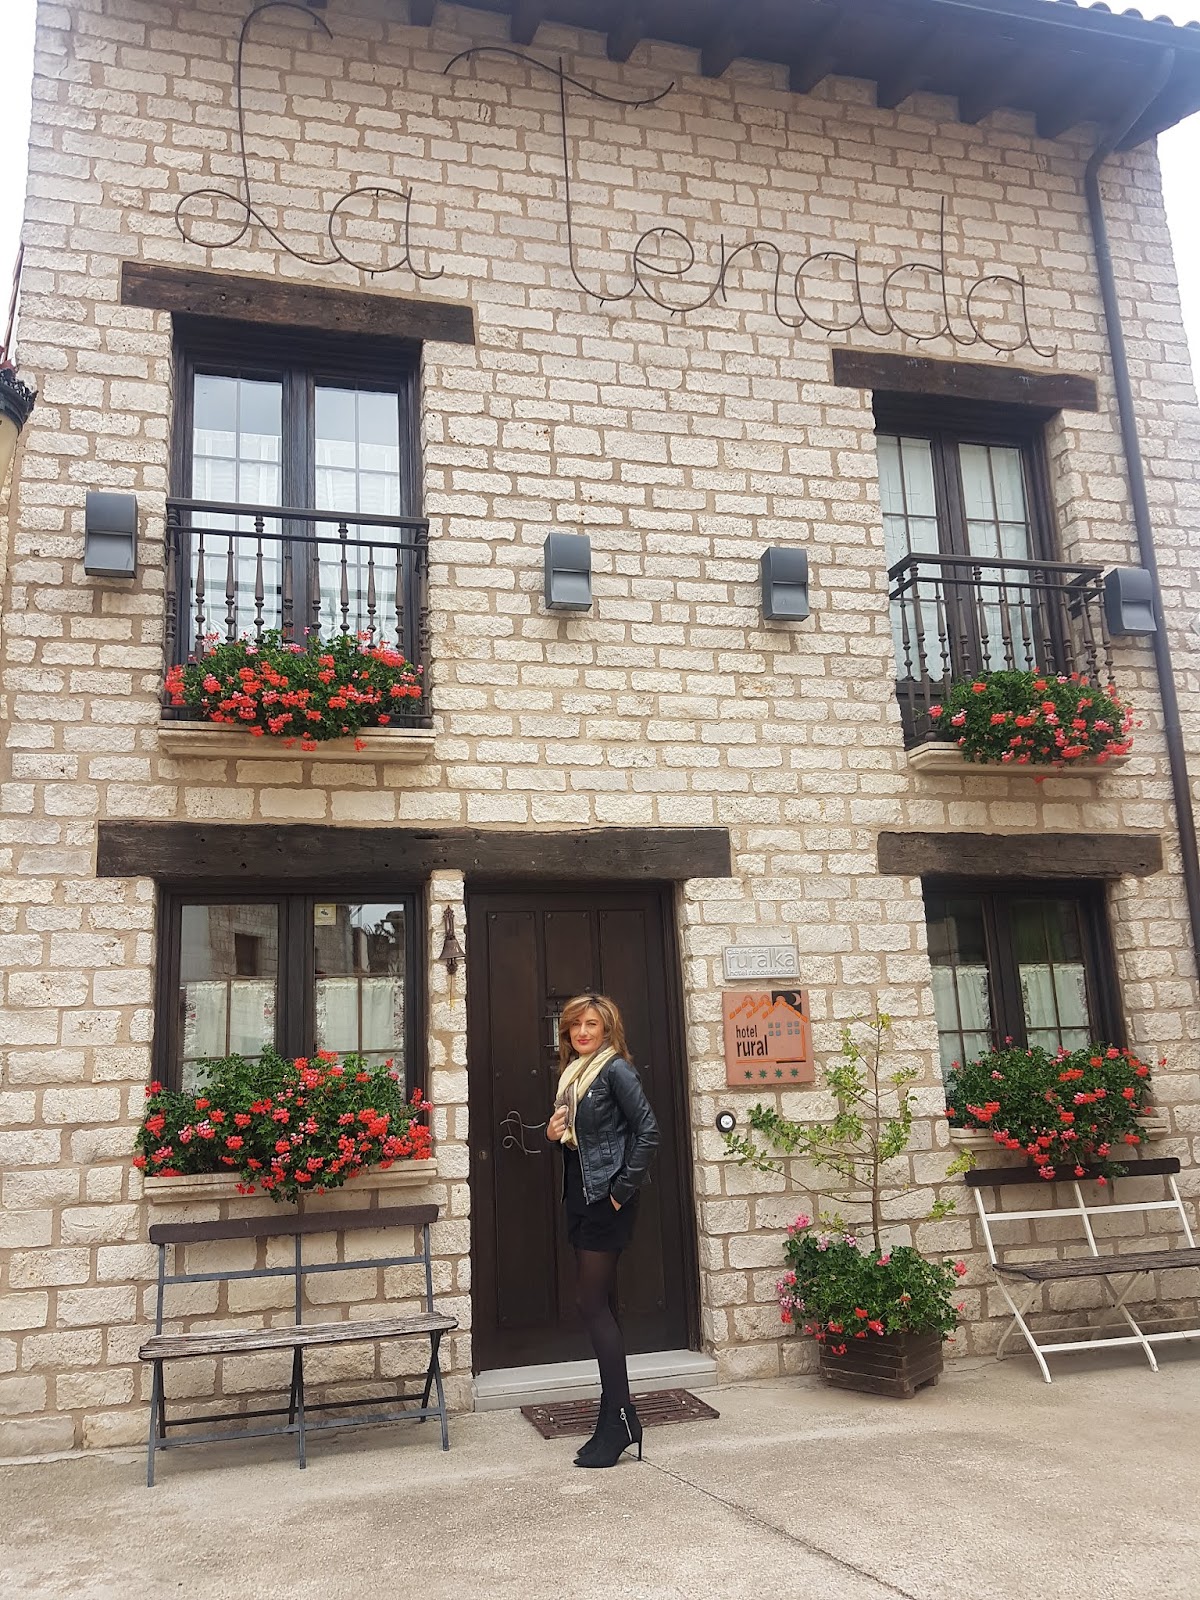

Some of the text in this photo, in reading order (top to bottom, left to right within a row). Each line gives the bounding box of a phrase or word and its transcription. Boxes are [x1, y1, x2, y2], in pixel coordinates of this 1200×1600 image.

[728, 948, 796, 968] ruralka
[736, 1024, 758, 1038] hotel
[736, 1034, 769, 1058] rural
